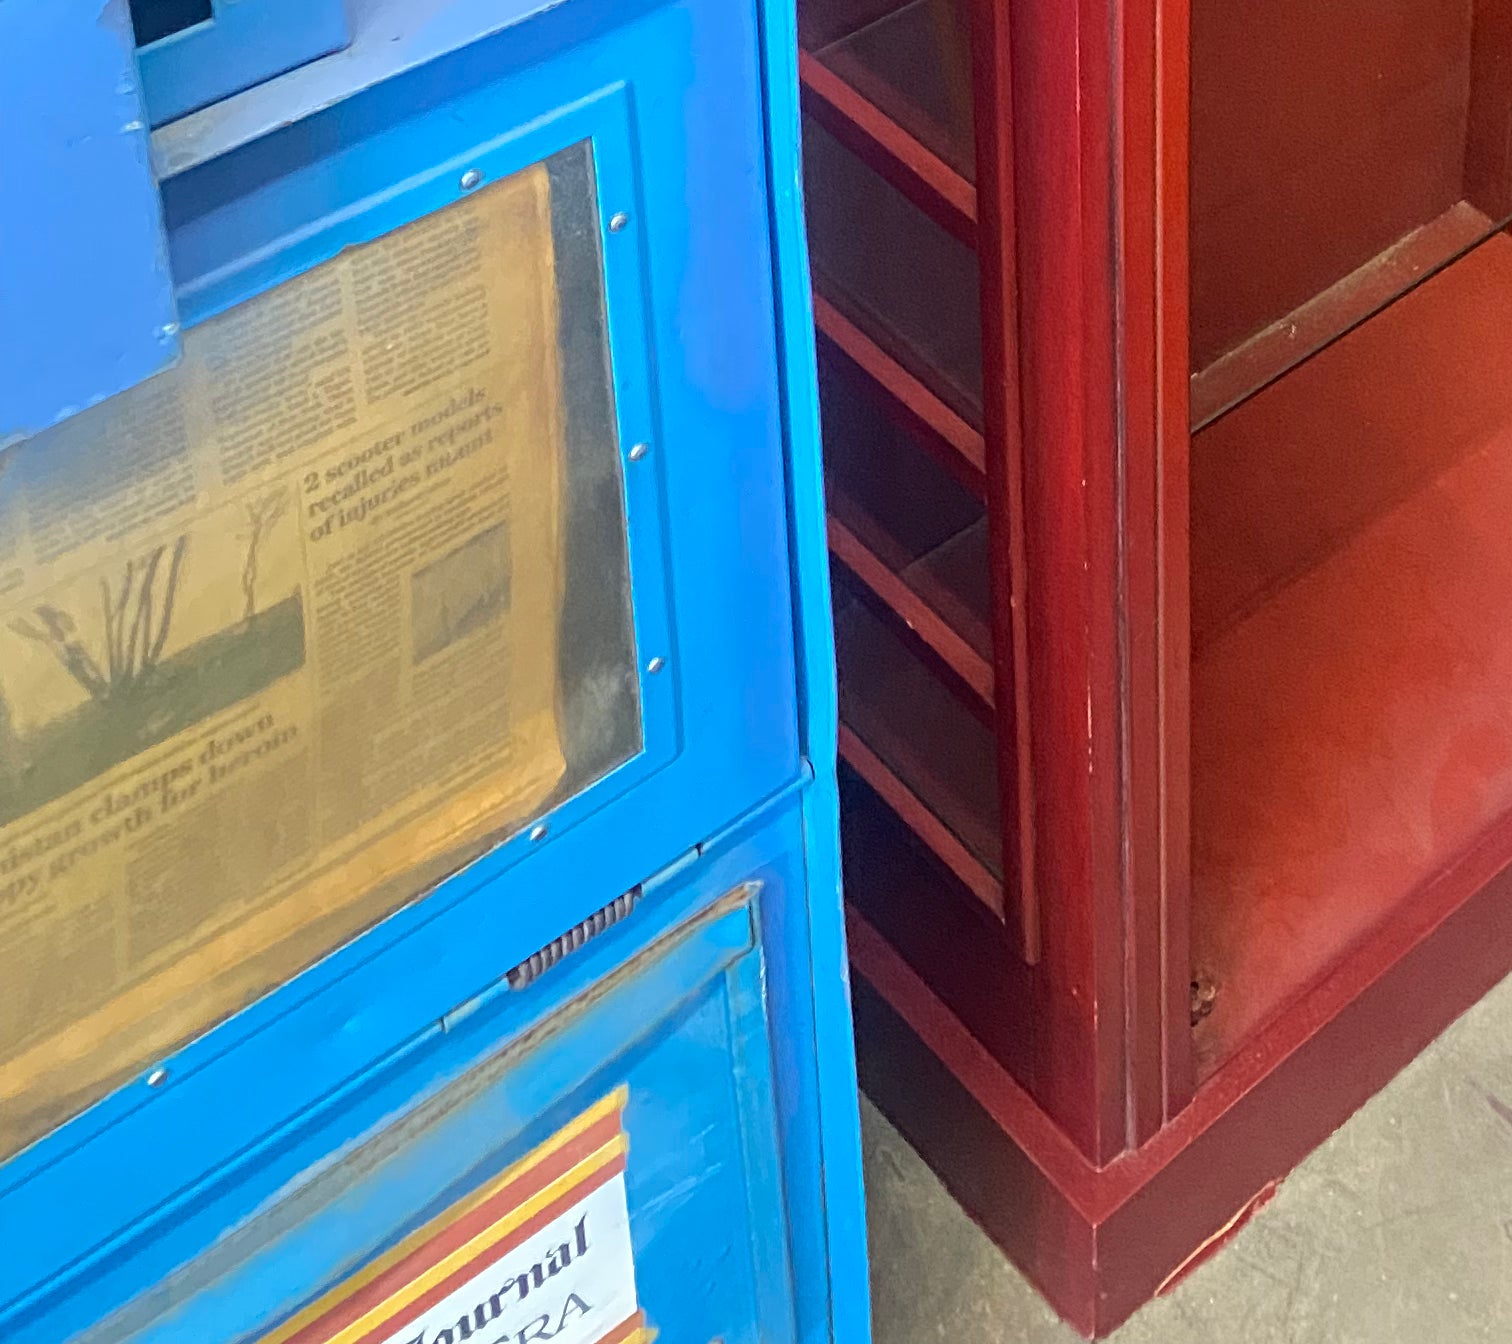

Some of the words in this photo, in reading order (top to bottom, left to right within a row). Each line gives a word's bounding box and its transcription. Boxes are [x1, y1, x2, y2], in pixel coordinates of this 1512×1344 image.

[303, 471, 320, 494] 2
[324, 429, 405, 484] scooter
[308, 455, 395, 518] recalled
[309, 513, 335, 542] of
[338, 471, 421, 528] injuries
[492, 1292, 595, 1344] RA
